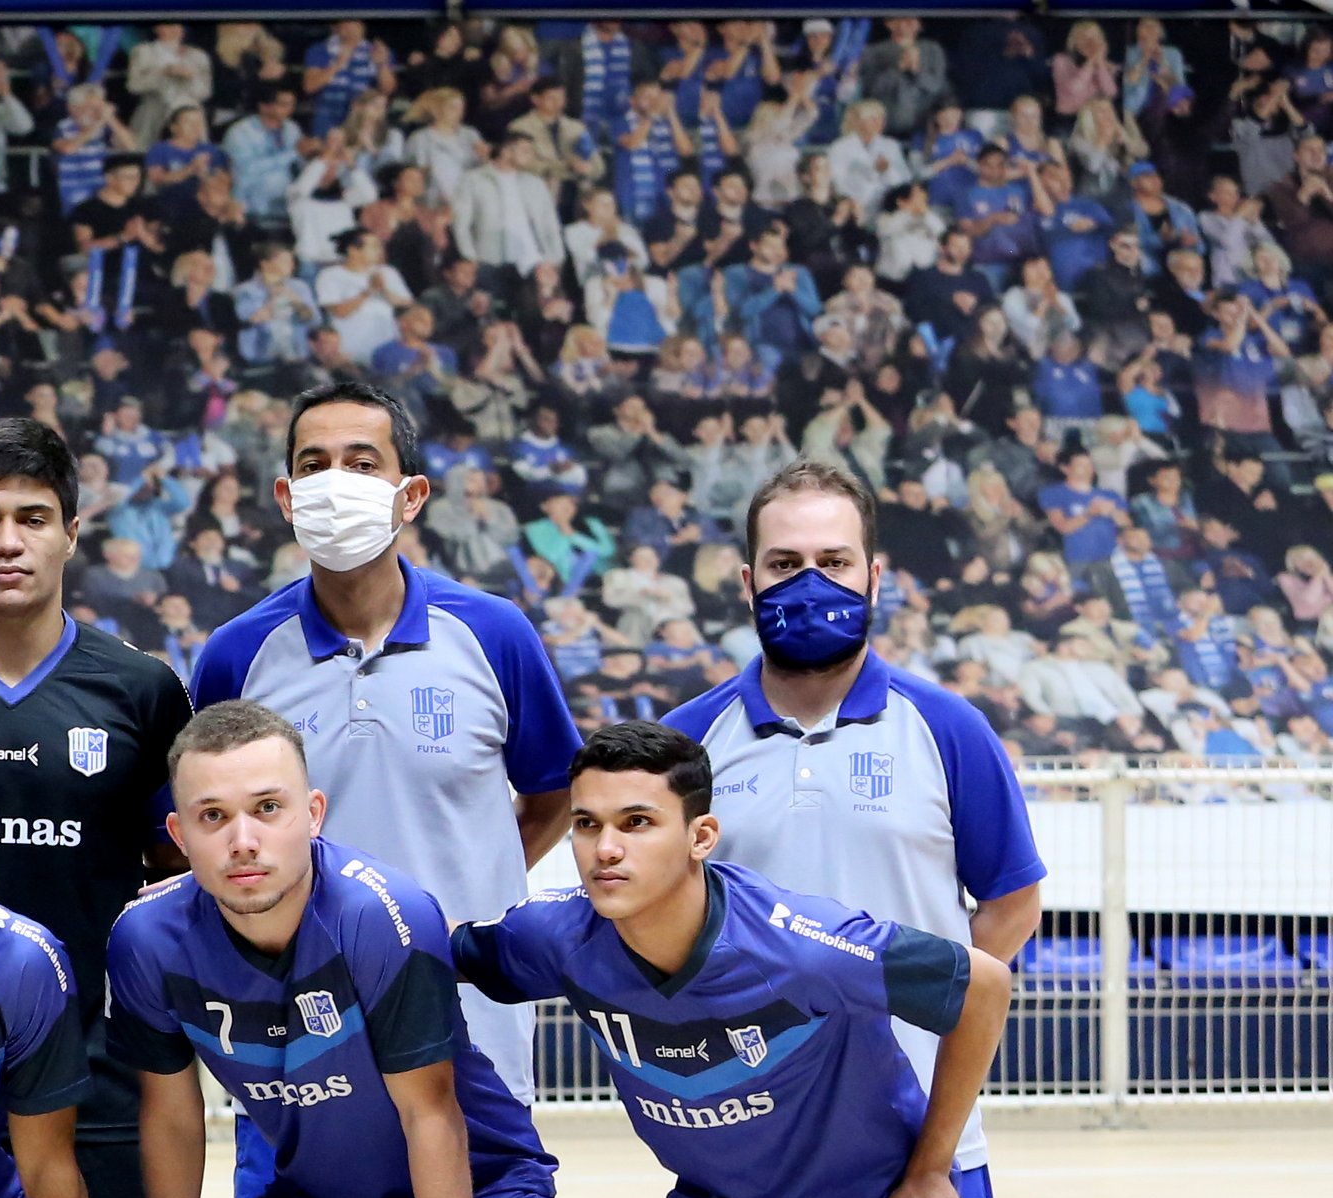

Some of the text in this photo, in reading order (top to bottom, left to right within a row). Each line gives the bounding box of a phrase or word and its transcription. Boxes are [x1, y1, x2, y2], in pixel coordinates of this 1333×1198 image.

[416, 745, 452, 754] FUTSAL
[853, 803, 889, 813] FUTSAL
[364, 866, 387, 885] Grupo
[355, 867, 412, 947] Risotolândia
[794, 913, 822, 928] Grupo
[10, 922, 69, 993] Risotolândia
[789, 918, 875, 962] Risotolândia
[205, 1001, 234, 1055] 7
[589, 1009, 642, 1068] 11
[635, 1090, 776, 1130] minas
